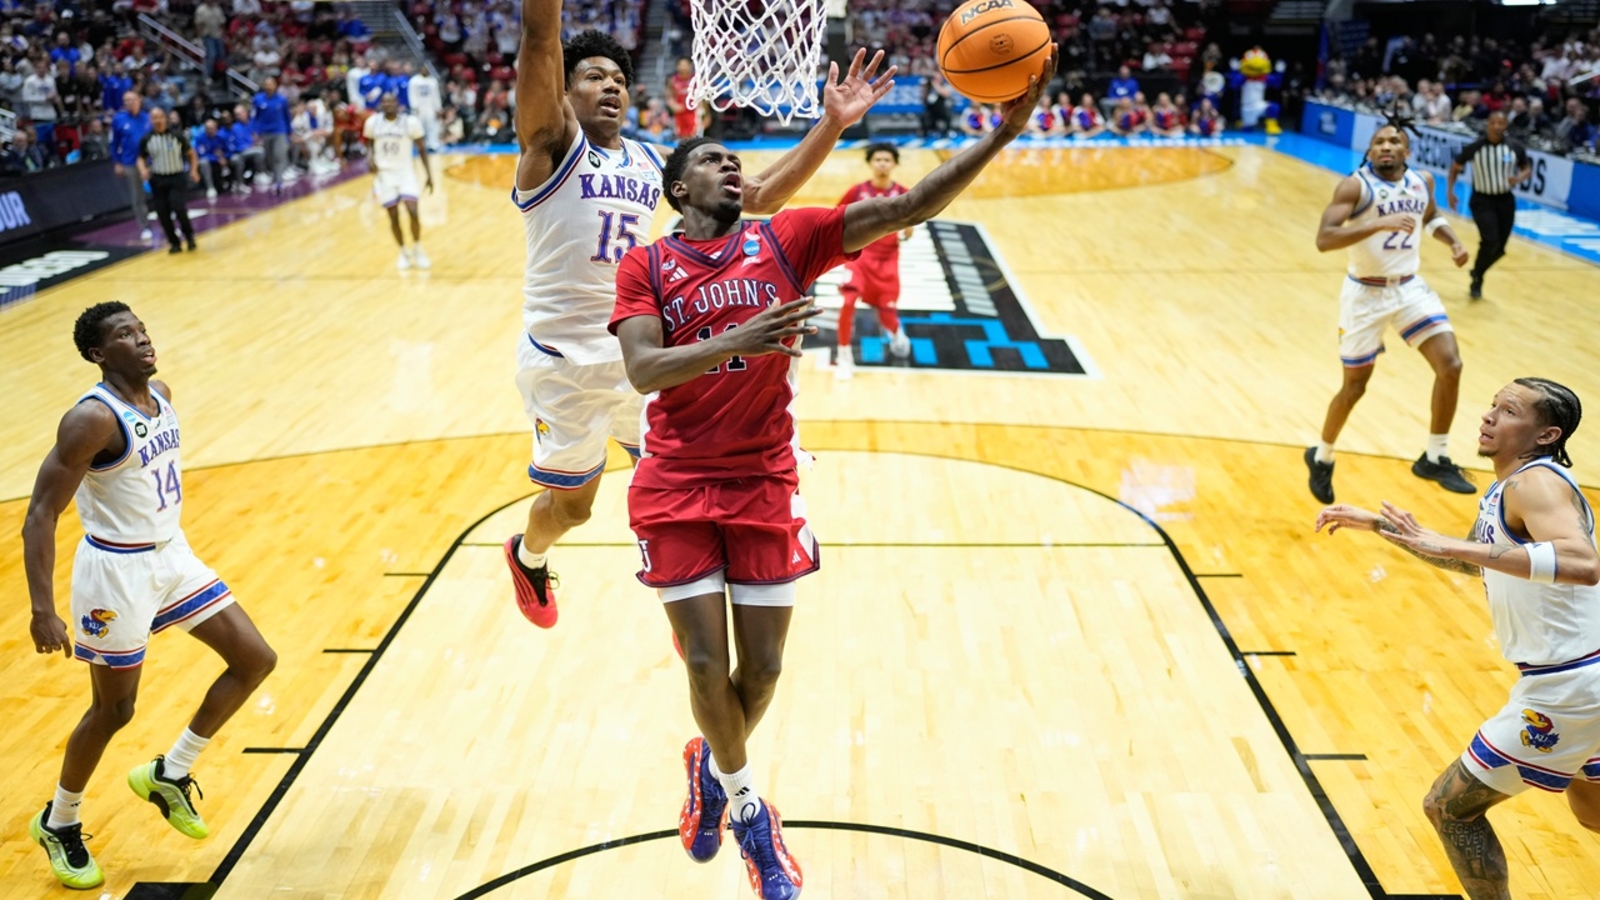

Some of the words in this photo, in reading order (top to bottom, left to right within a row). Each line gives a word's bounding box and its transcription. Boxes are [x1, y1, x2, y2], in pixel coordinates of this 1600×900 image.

[960, 0, 1014, 25] NCAA
[0, 191, 31, 232] UR
[578, 173, 661, 212] KANSAS
[1376, 198, 1425, 218] KANSAS
[590, 210, 640, 264] 15
[1383, 230, 1413, 250] 22
[662, 297, 691, 332] ST.
[694, 279, 777, 314] JOHN'S
[138, 428, 180, 469] KANSAS
[151, 459, 182, 513] 14
[1450, 830, 1484, 847] NEVER
[1465, 845, 1482, 860] DE
